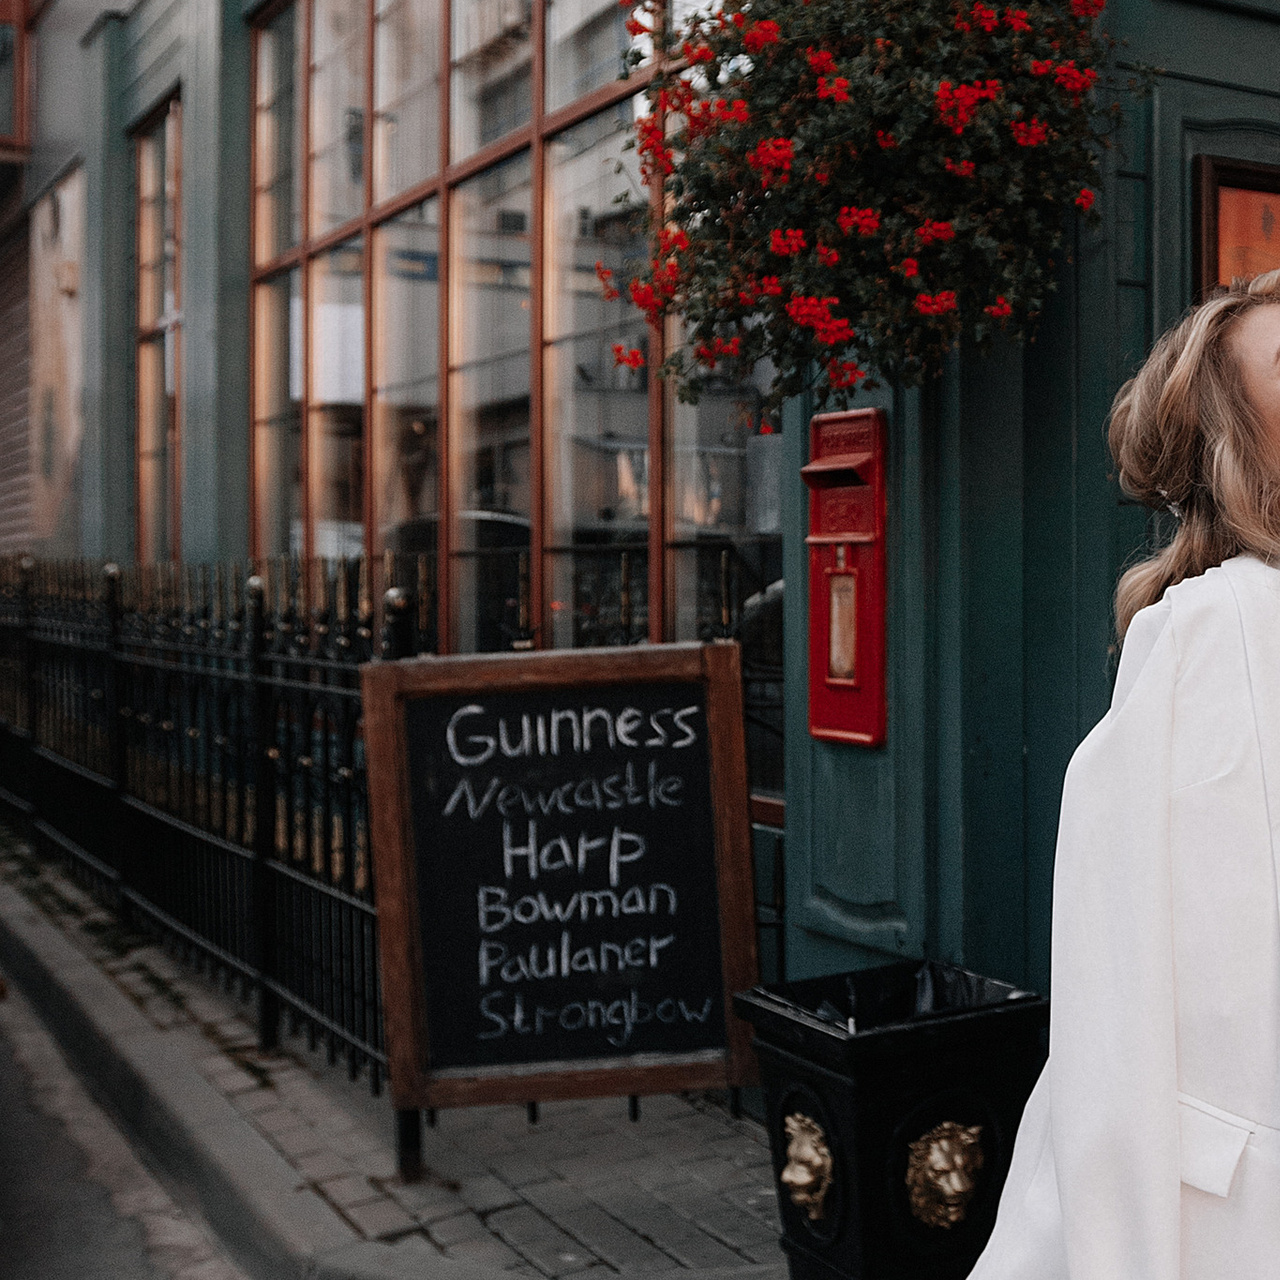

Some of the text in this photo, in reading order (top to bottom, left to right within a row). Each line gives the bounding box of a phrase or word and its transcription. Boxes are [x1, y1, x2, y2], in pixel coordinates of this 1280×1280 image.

[446, 704, 699, 766] Guinness
[443, 761, 685, 819] Newcastle
[503, 819, 645, 887] Harp
[477, 883, 677, 932] Bowman
[479, 931, 675, 986] Paulaner
[478, 990, 712, 1046] Strongbow
